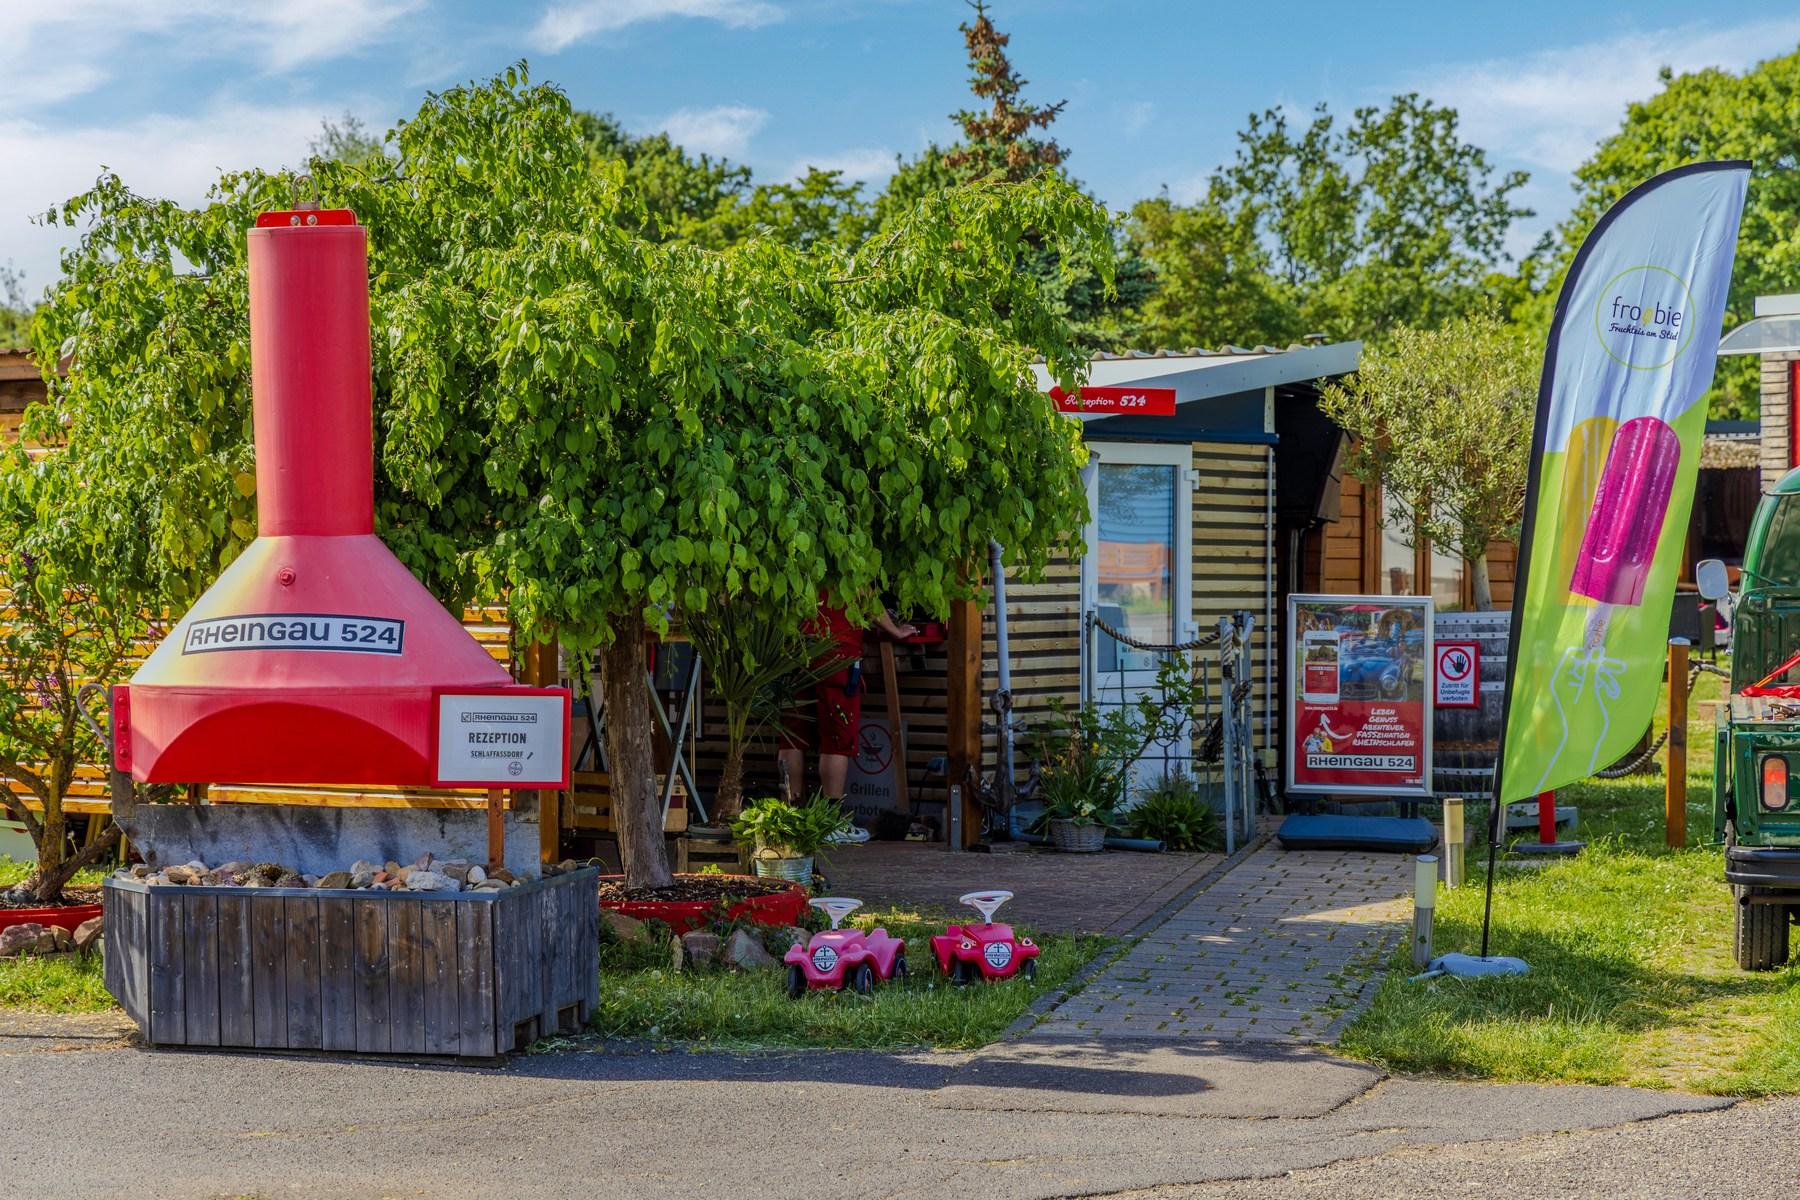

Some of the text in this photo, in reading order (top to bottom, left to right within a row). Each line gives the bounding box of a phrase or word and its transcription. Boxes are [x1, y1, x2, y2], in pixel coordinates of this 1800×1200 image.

[1609, 323, 1645, 336] Fruchteis
[1119, 395, 1146, 407] 524
[341, 623, 397, 645] 524
[468, 732, 527, 744] REZEPTION
[1388, 758, 1412, 767] 524
[850, 782, 889, 797] Grillen
